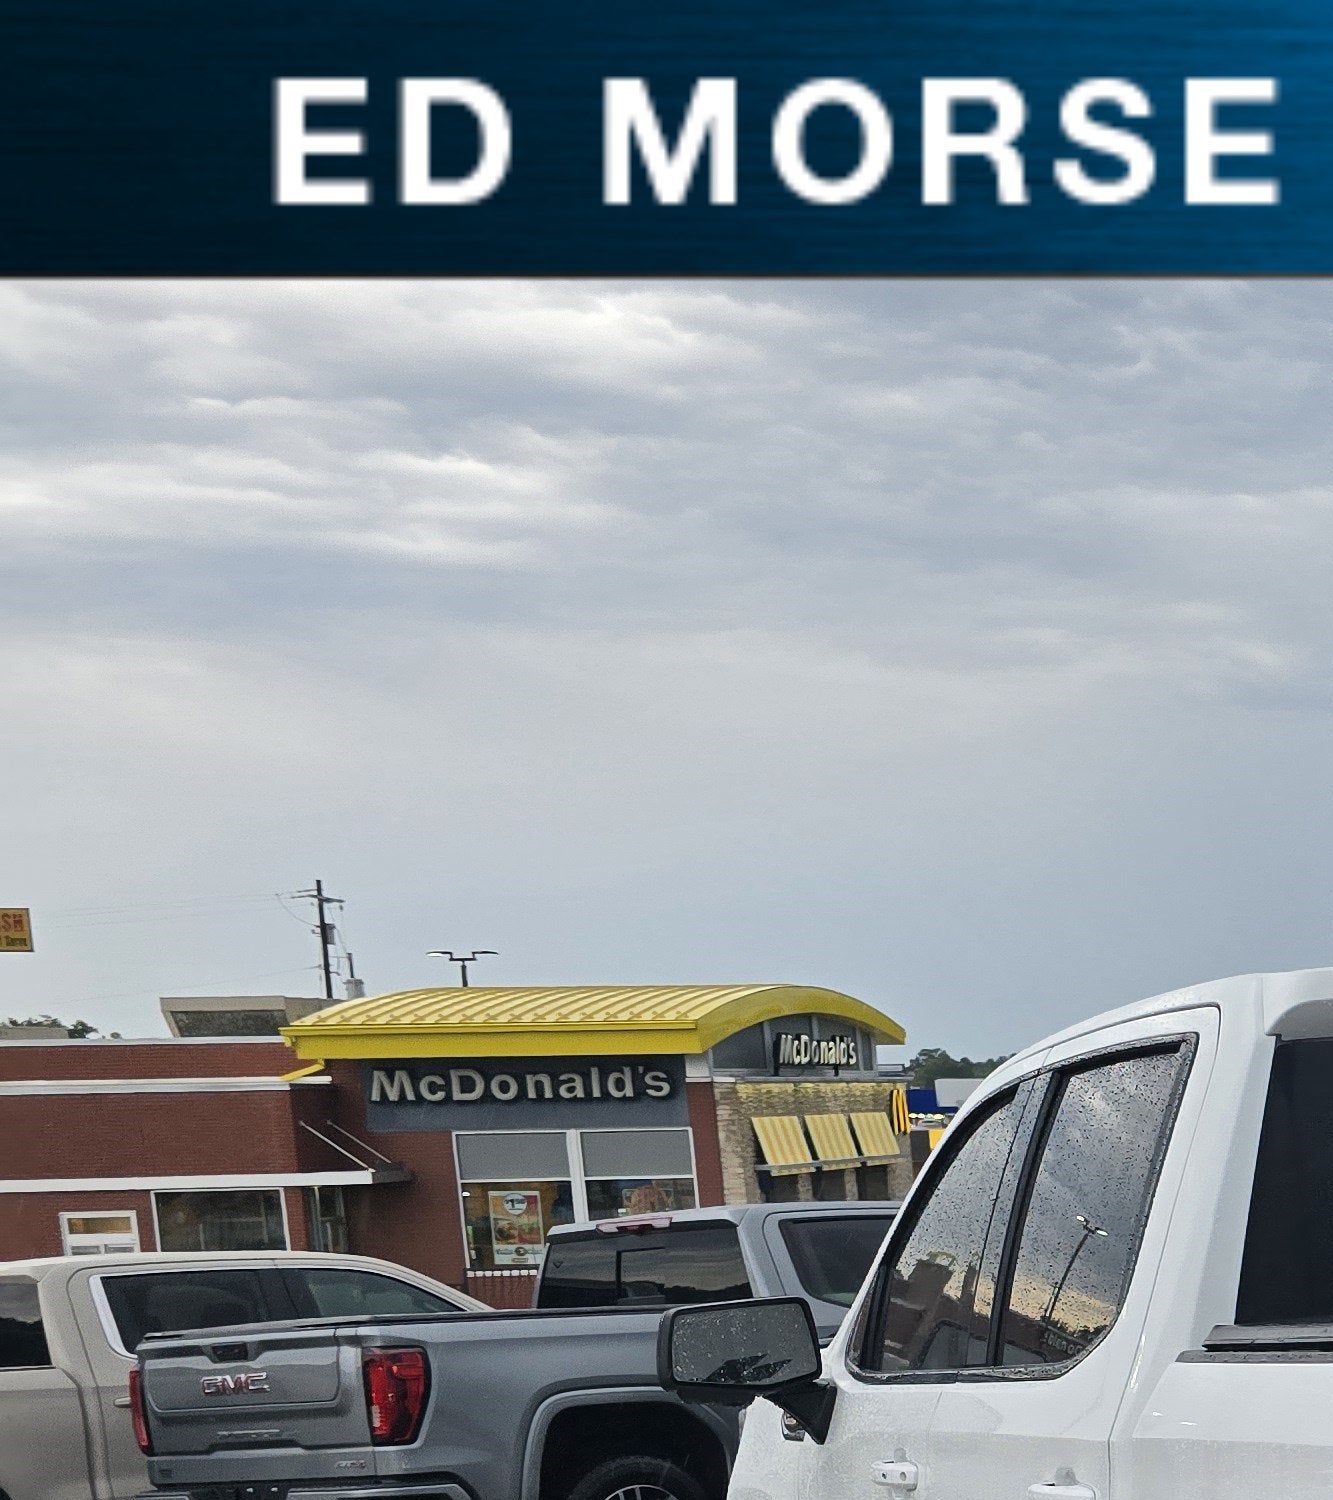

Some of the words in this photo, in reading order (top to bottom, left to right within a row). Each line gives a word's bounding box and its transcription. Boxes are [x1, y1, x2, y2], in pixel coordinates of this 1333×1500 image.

[774, 1034, 857, 1066] McDonald's
[369, 1065, 672, 1103] McDonald's
[201, 1371, 271, 1396] GMC
